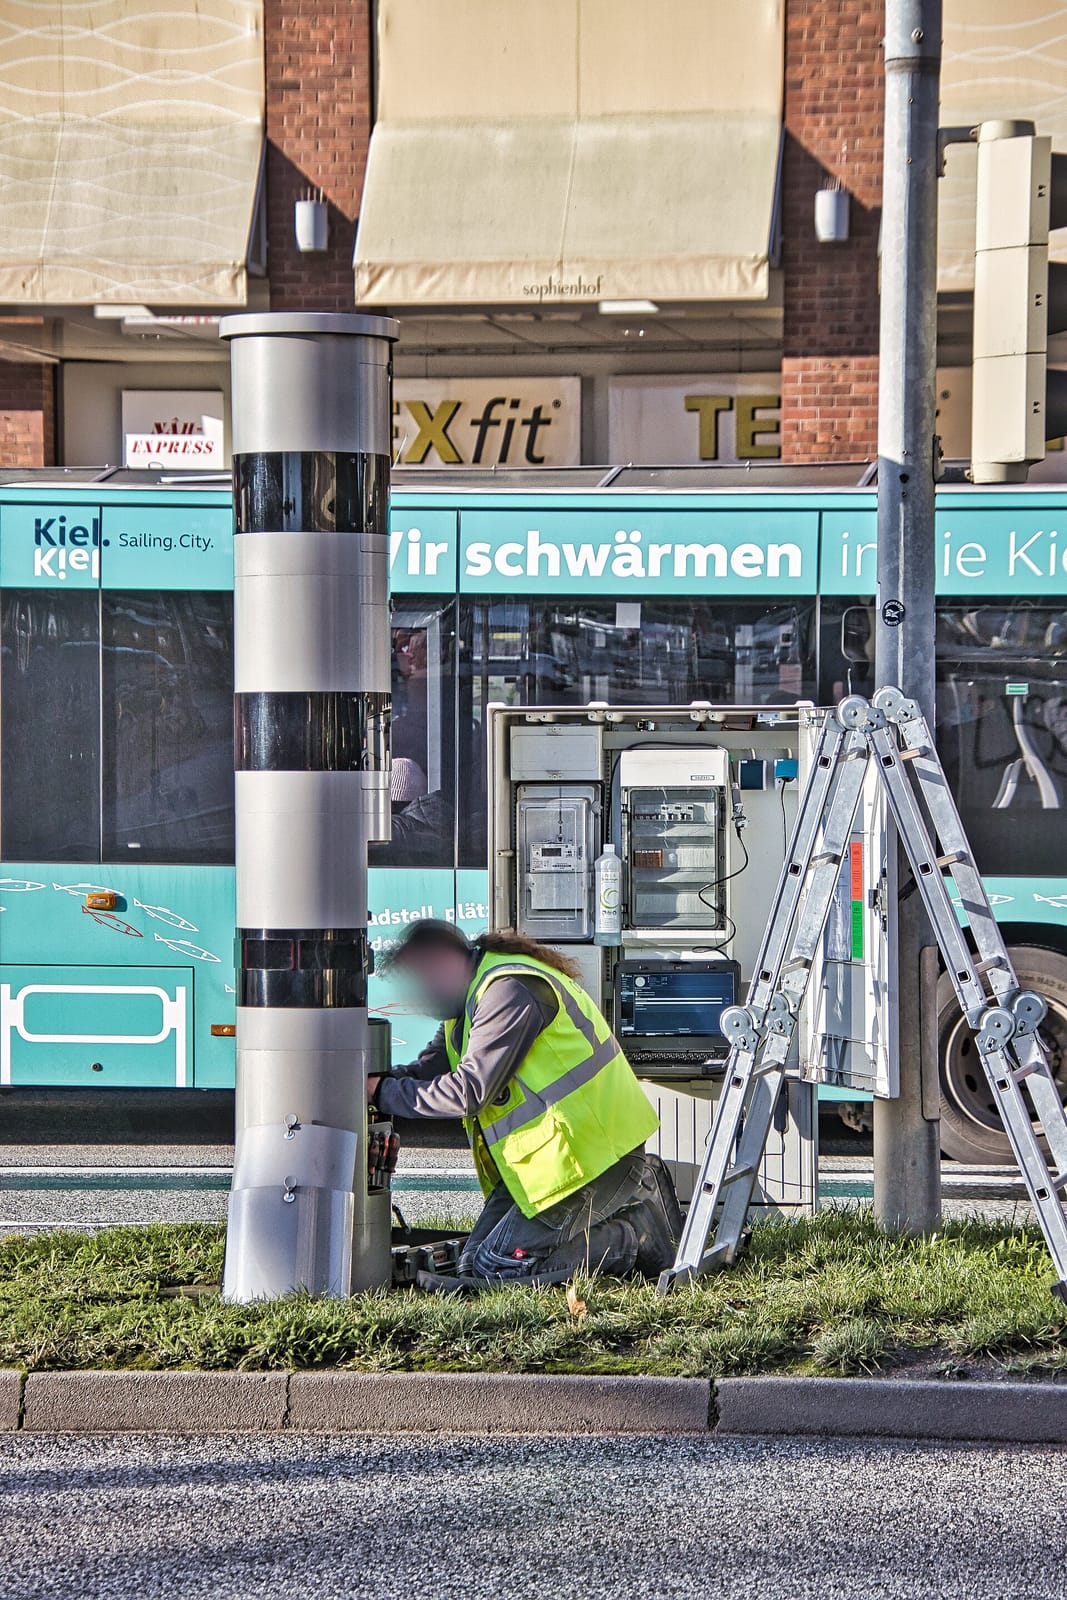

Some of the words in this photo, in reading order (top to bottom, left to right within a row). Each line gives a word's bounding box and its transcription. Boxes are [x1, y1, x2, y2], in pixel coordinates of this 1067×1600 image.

[523, 275, 604, 304] sophienhof
[684, 395, 782, 460] TE
[132, 440, 214, 454] EXPRESS
[465, 530, 801, 577] schwärmen
[943, 531, 987, 577] ie
[1008, 530, 1067, 577] Ki
[368, 905, 433, 926] adstell
[445, 902, 488, 921] plät
